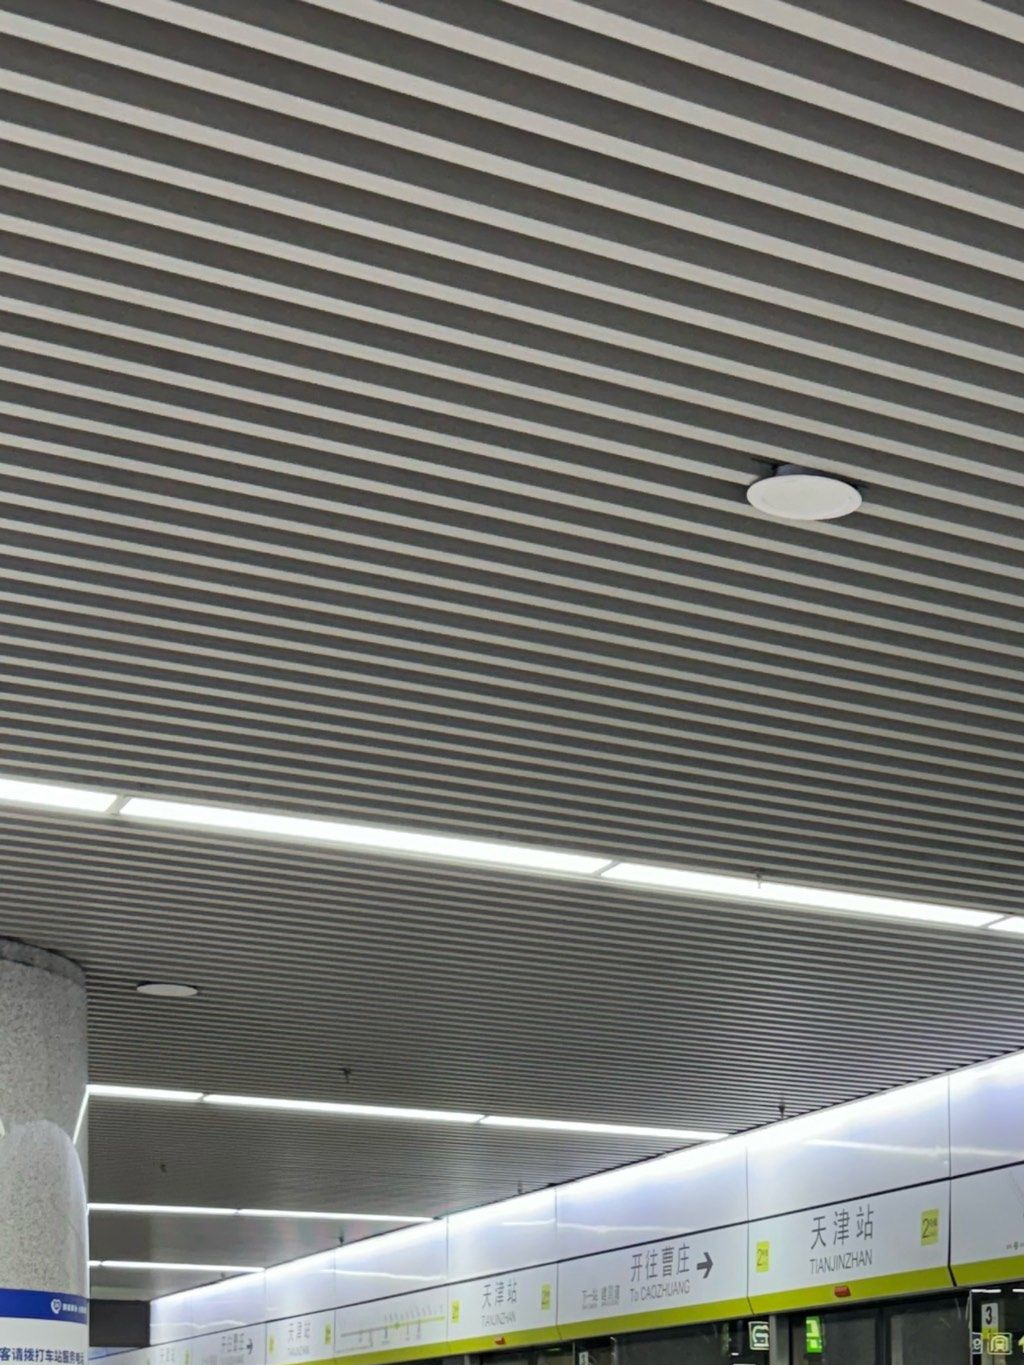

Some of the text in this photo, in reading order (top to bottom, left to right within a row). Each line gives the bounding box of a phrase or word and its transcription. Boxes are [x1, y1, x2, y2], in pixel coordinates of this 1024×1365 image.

[810, 1203, 875, 1250] 天津站
[630, 1242, 690, 1283] 开往曹庄
[809, 1249, 874, 1275] TIANJINZHAN
[985, 1306, 993, 1325] 3
